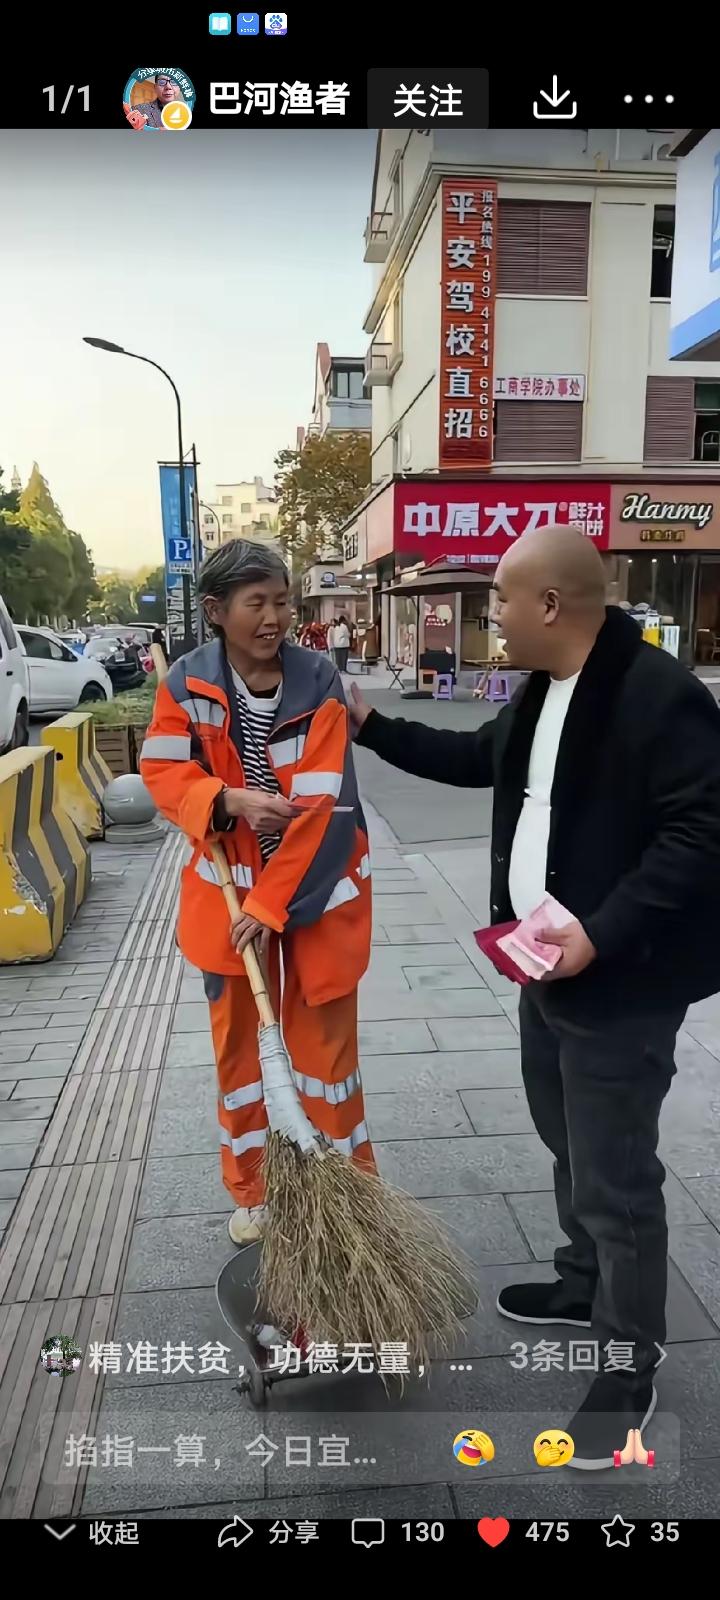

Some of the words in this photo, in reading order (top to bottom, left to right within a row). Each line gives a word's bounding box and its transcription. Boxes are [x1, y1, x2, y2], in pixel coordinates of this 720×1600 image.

[481, 254, 491, 298] 199
[445, 192, 477, 439] 平安驾校直招
[480, 306, 490, 367] 4141
[478, 376, 489, 438] 6666
[495, 378, 579, 398] 工商学院办事处
[403, 502, 557, 537] 中原大刀
[622, 495, 713, 527] Hanmy
[173, 539, 187, 560] P
